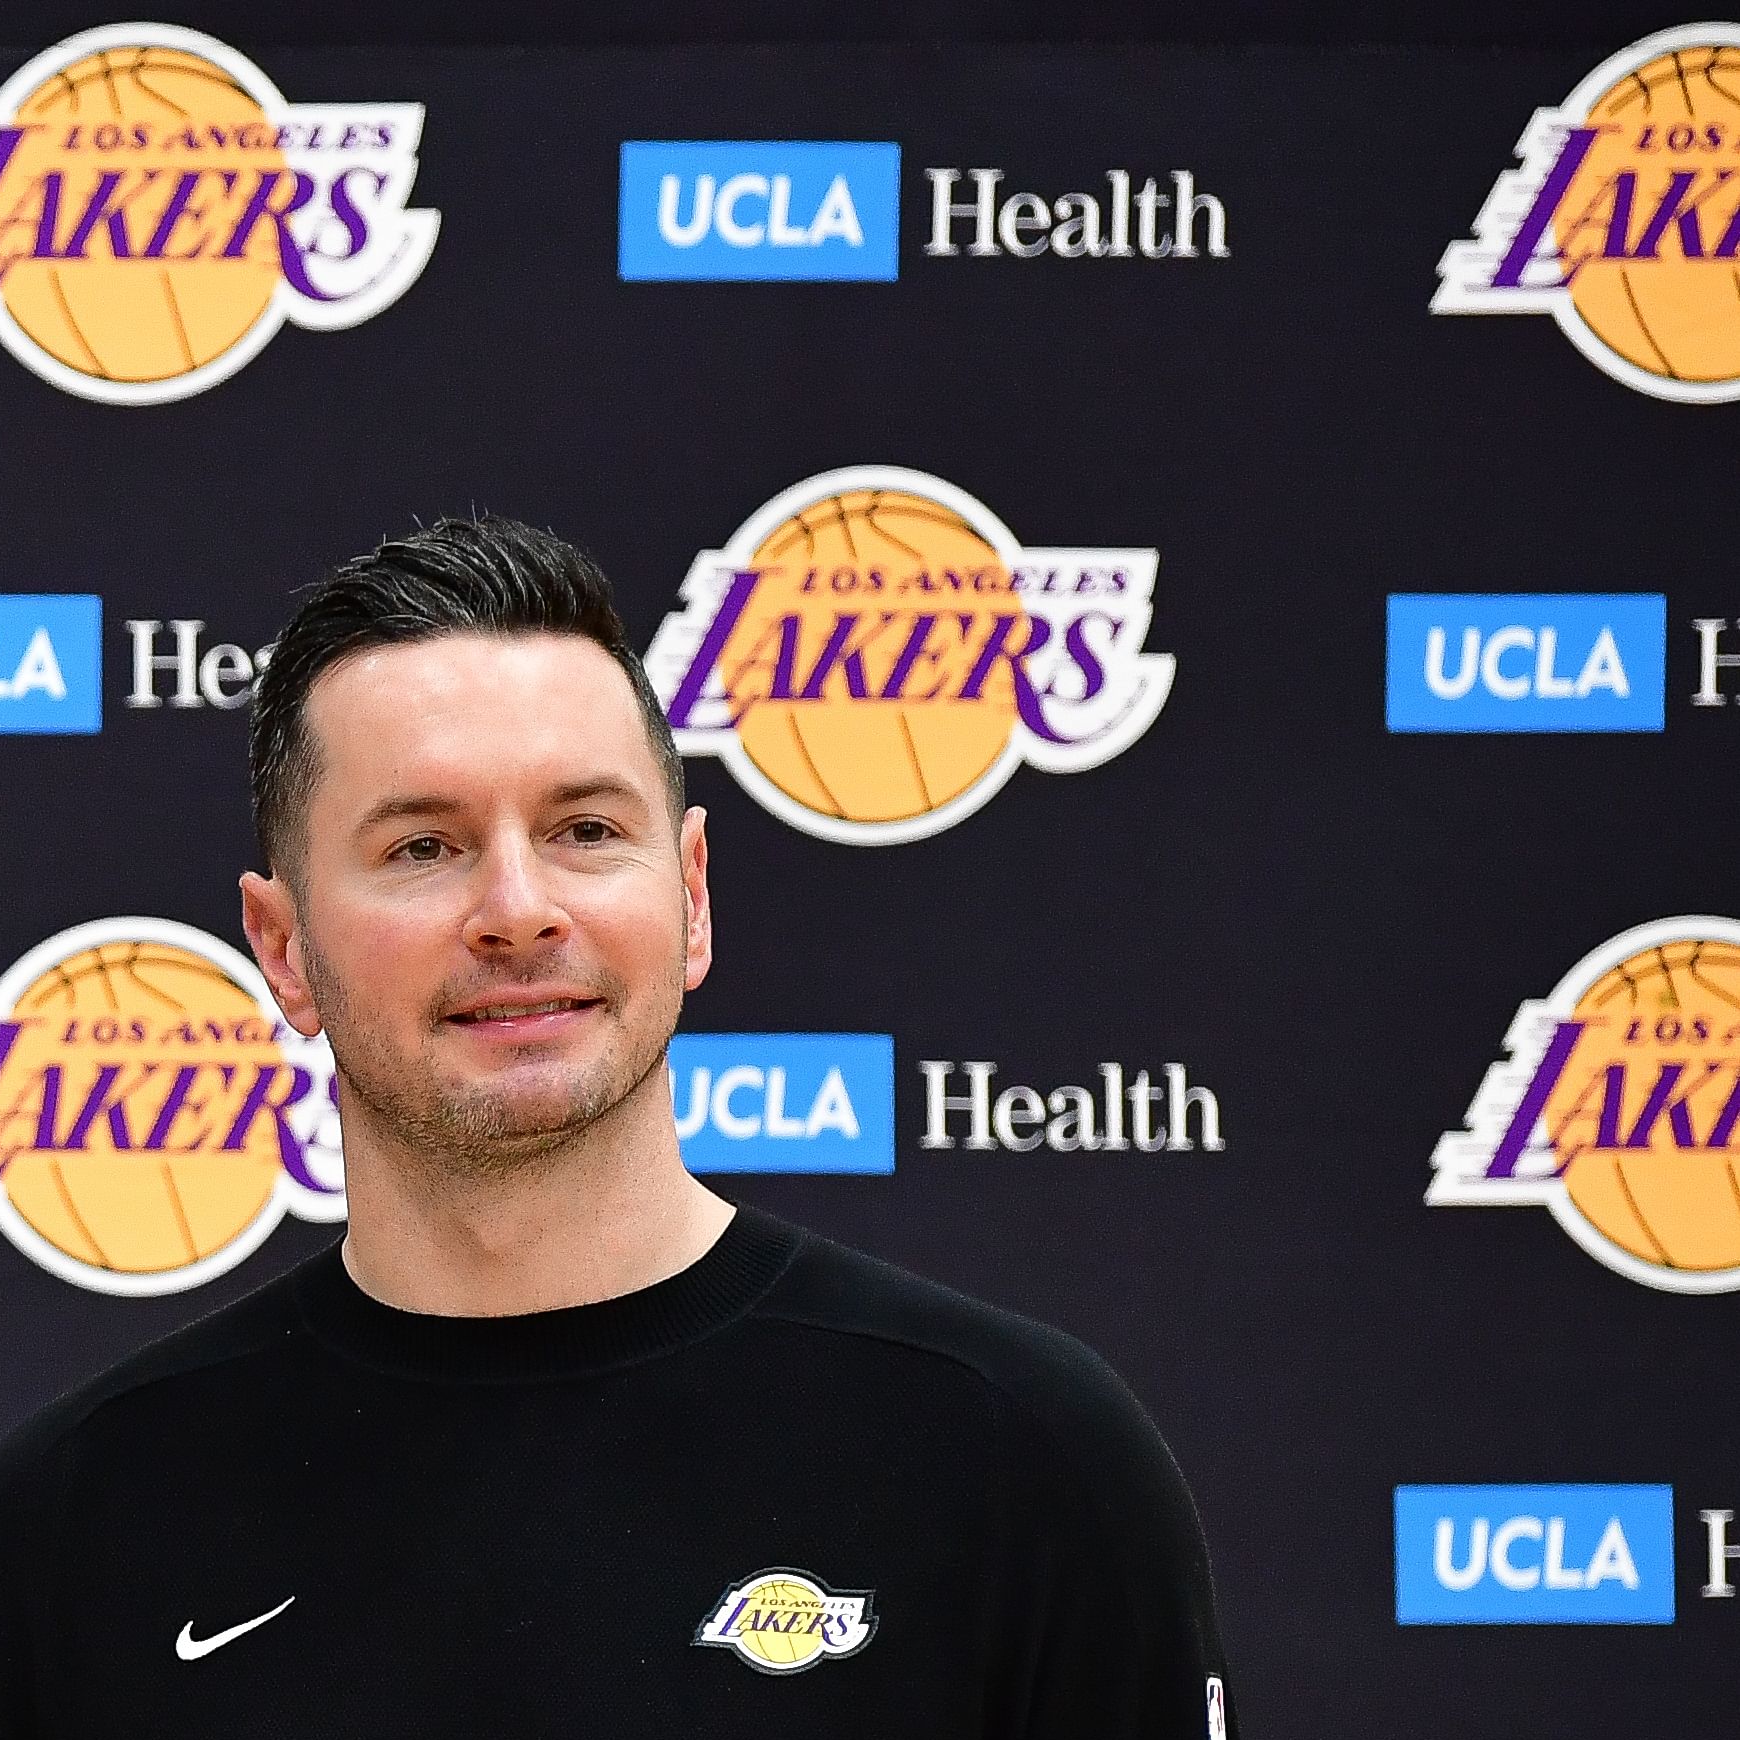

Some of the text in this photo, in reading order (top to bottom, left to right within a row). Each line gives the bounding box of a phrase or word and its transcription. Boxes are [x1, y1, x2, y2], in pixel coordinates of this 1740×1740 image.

[61, 123, 393, 151] LOS ANGELES
[1635, 124, 1726, 153] LOS
[657, 168, 1231, 258] UCLA Health
[1463, 125, 1740, 292] LAK
[799, 567, 1128, 593] LOS ANGELES
[667, 565, 1147, 745] LAKERS
[1424, 625, 1632, 700] UCLA
[59, 1016, 152, 1044] LOS
[1625, 1016, 1713, 1045] LOS
[669, 1061, 1226, 1152] UCLA Health
[1459, 1016, 1740, 1184] LAK
[1433, 1515, 1641, 1591] UCLA
[718, 1597, 855, 1648] LAKERS
[760, 1598, 786, 1607] LOS
